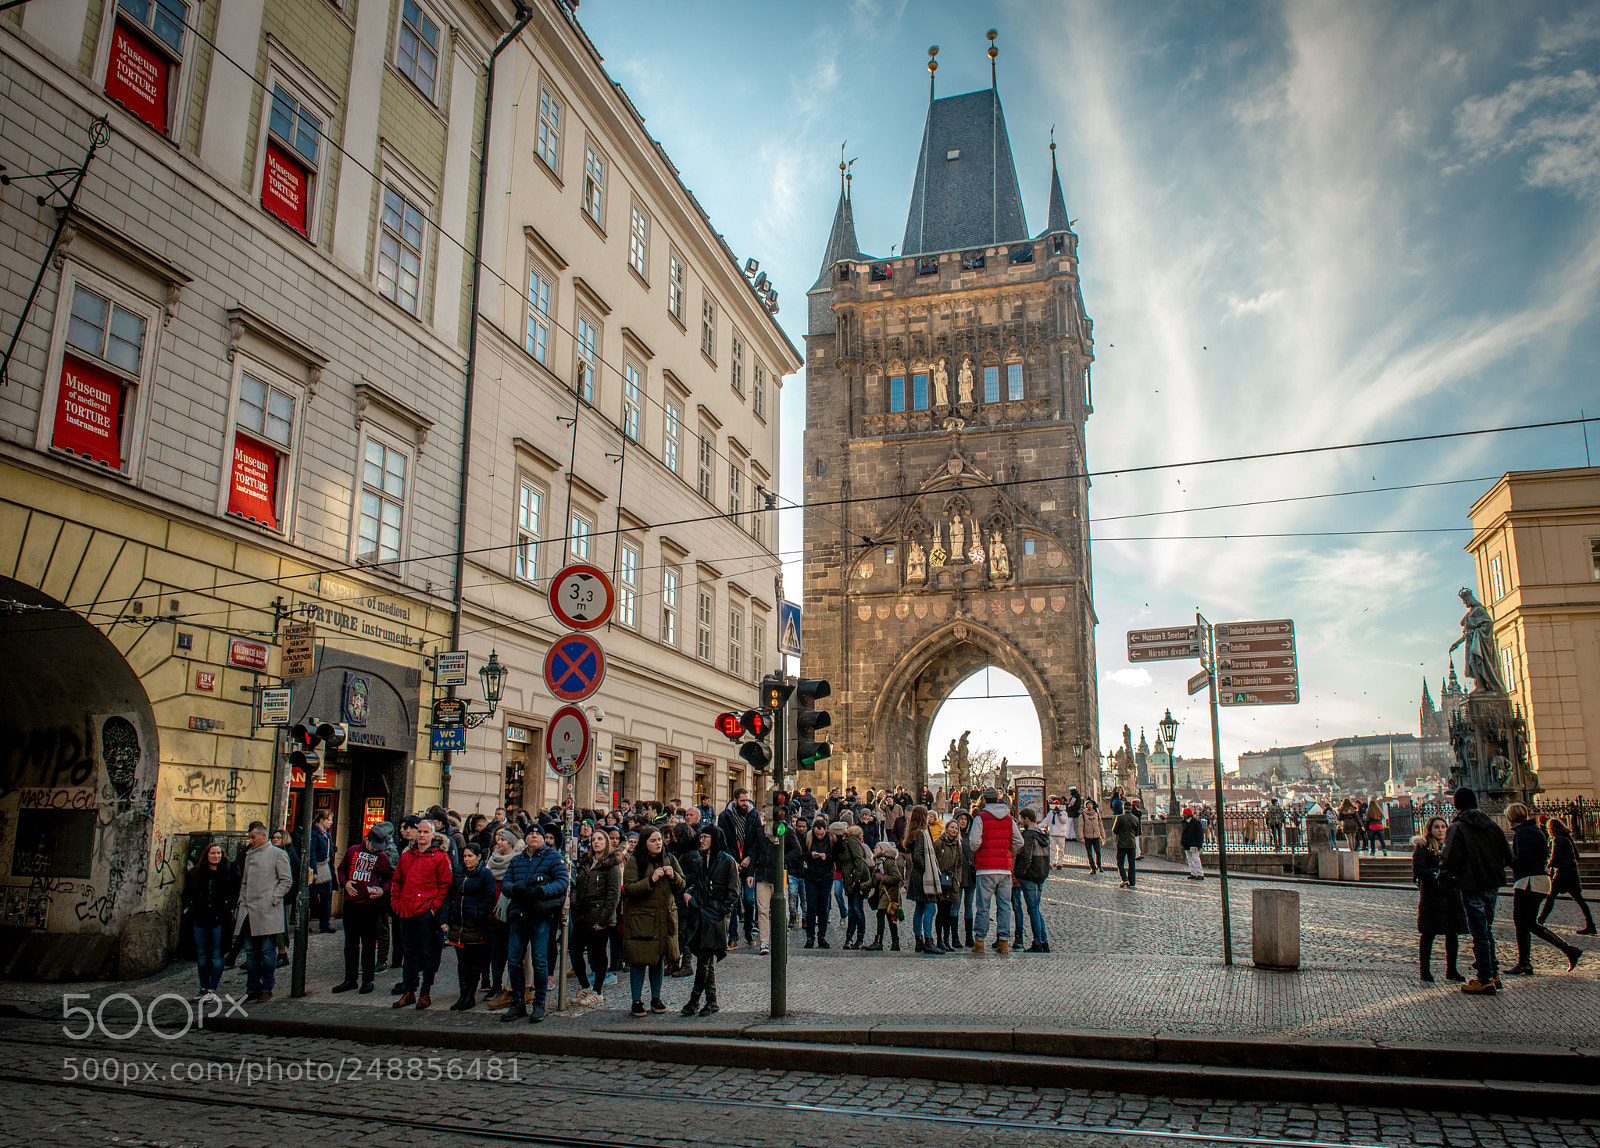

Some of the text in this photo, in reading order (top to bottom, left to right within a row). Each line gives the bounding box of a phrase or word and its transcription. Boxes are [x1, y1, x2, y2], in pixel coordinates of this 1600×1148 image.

[118, 36, 158, 77] Museum
[120, 53, 154, 82] of medieval
[117, 59, 157, 96] TORTURE
[117, 71, 155, 104] instruments
[268, 154, 299, 186] Museum
[269, 174, 299, 204] TORTURE
[277, 174, 296, 191] medieval
[270, 185, 297, 210] instruments
[66, 372, 111, 404] Museum
[69, 391, 107, 412] of medieval
[65, 400, 110, 428] TORTURE
[66, 413, 108, 437] instruments
[235, 448, 269, 473] Museum
[235, 471, 269, 493] TORTURE
[244, 466, 266, 480] medieval
[236, 482, 267, 501] instruments
[570, 583, 593, 602] 3,3
[367, 597, 376, 609] of
[377, 601, 410, 620] medieval
[299, 601, 412, 646] TORTURE instruments
[1142, 632, 1161, 641] Muzeum
[1167, 631, 1188, 640] Smetany
[1149, 647, 1189, 657] Národní divadlo
[201, 673, 212, 682] 194
[1237, 694, 1244, 702] A
[348, 731, 385, 746] AMOUNA
[353, 870, 371, 882] OUT!
